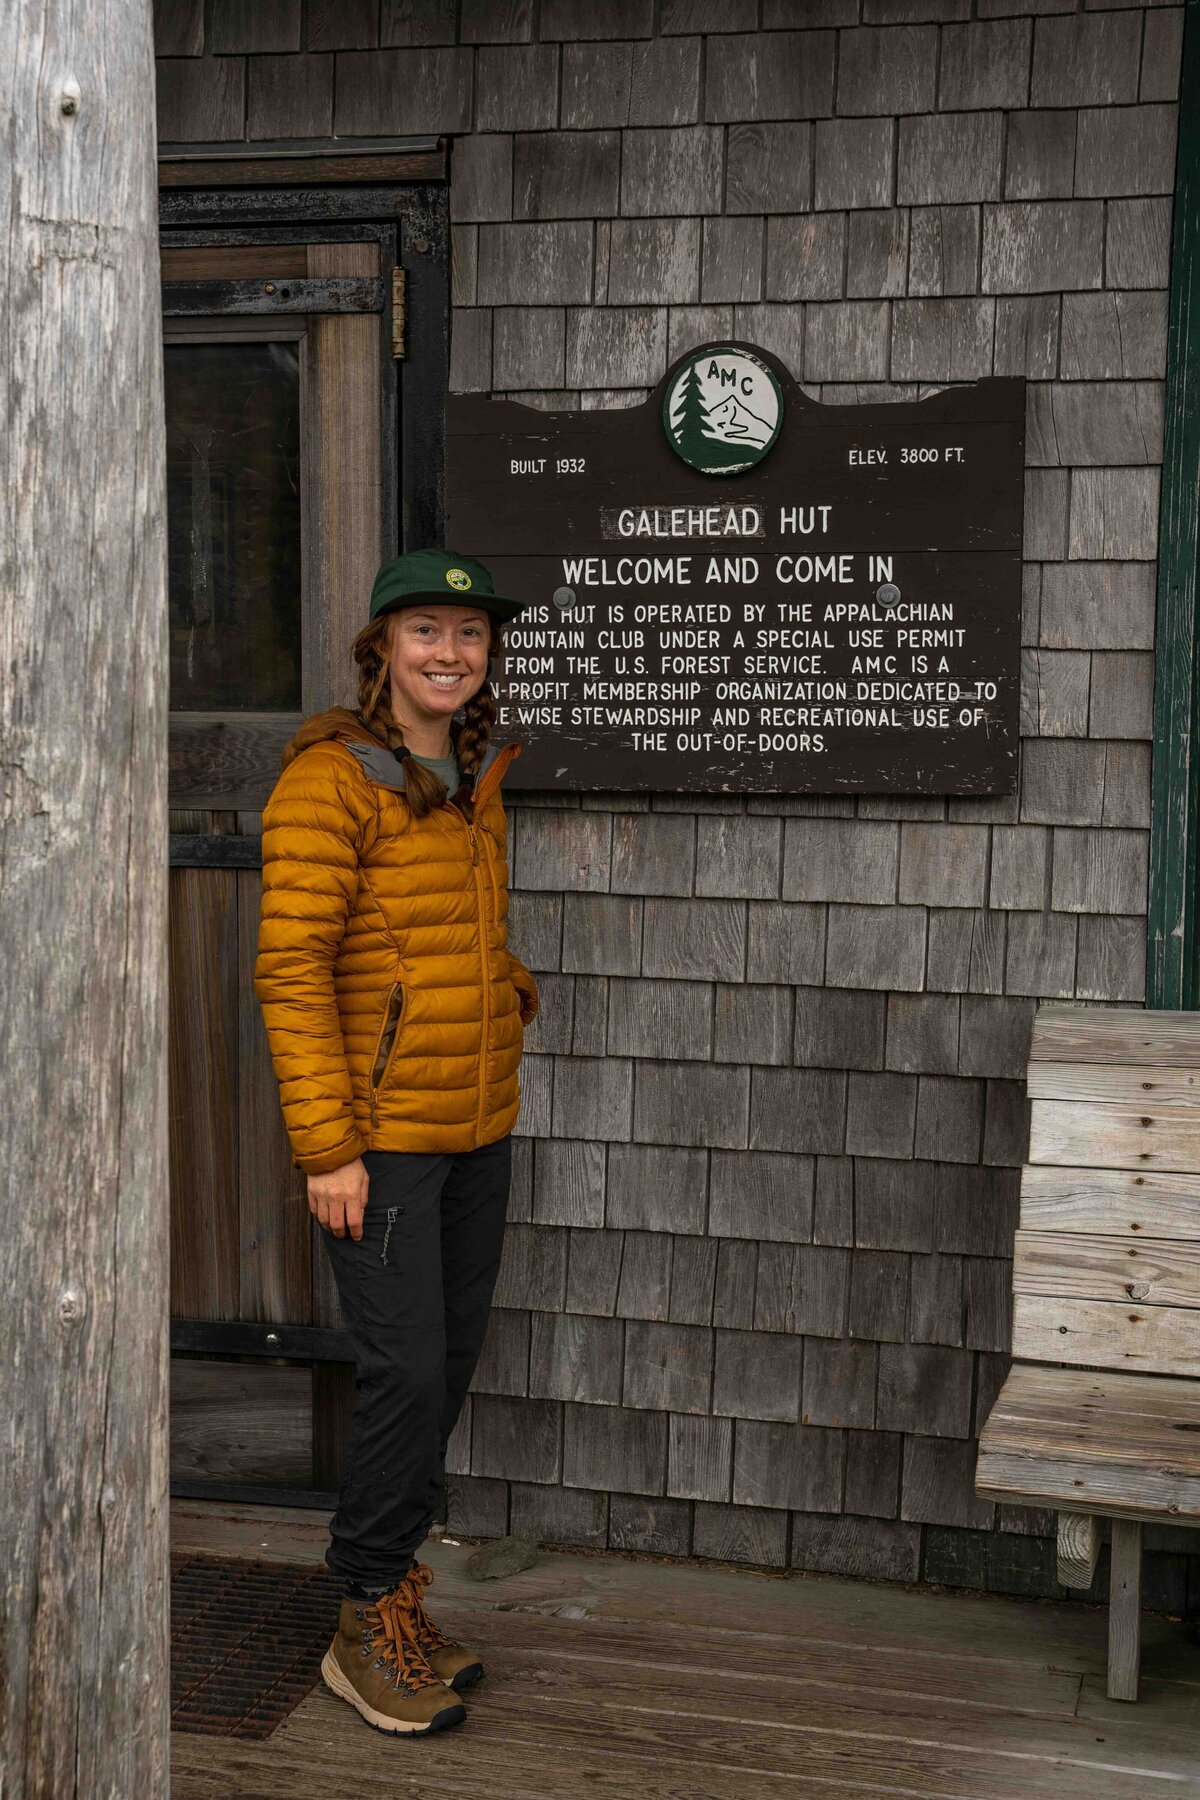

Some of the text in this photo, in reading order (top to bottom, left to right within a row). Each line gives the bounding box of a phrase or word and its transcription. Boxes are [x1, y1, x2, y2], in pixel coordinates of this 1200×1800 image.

[707, 360, 753, 396] AMC
[511, 458, 585, 474] BUILT 1932
[848, 447, 965, 465] ELEV. 3800 FT.
[617, 506, 832, 537] GALEHEAD HUT
[563, 555, 893, 585] WELCOME AND COME IN
[561, 605, 596, 624] HUT
[608, 605, 624, 623] IS
[634, 604, 731, 623] OPERATED
[743, 604, 766, 622] BY
[777, 604, 813, 622] THE
[824, 603, 953, 622] APPALACHIAN
[597, 630, 645, 649] CLUB
[659, 630, 720, 649] UNDER
[733, 630, 745, 649] A
[757, 629, 834, 648] SPECIAL
[848, 629, 884, 648] USE
[897, 629, 966, 648] PERMIT
[505, 655, 950, 675] FROM THE U.S. FOREST SERVICE. AMC IS A
[490, 681, 997, 701] N-PROFIT MEMBERSHIP ORGANIZATION DEDICATED TO
[517, 707, 562, 725] WISE
[571, 707, 701, 726] STEWARDSHIP
[711, 707, 750, 726] AND
[760, 707, 902, 727] RECREATIONAL
[913, 708, 950, 727] USE
[959, 707, 984, 727] OF
[631, 732, 828, 753] THE OUT-OF-DOORS.
